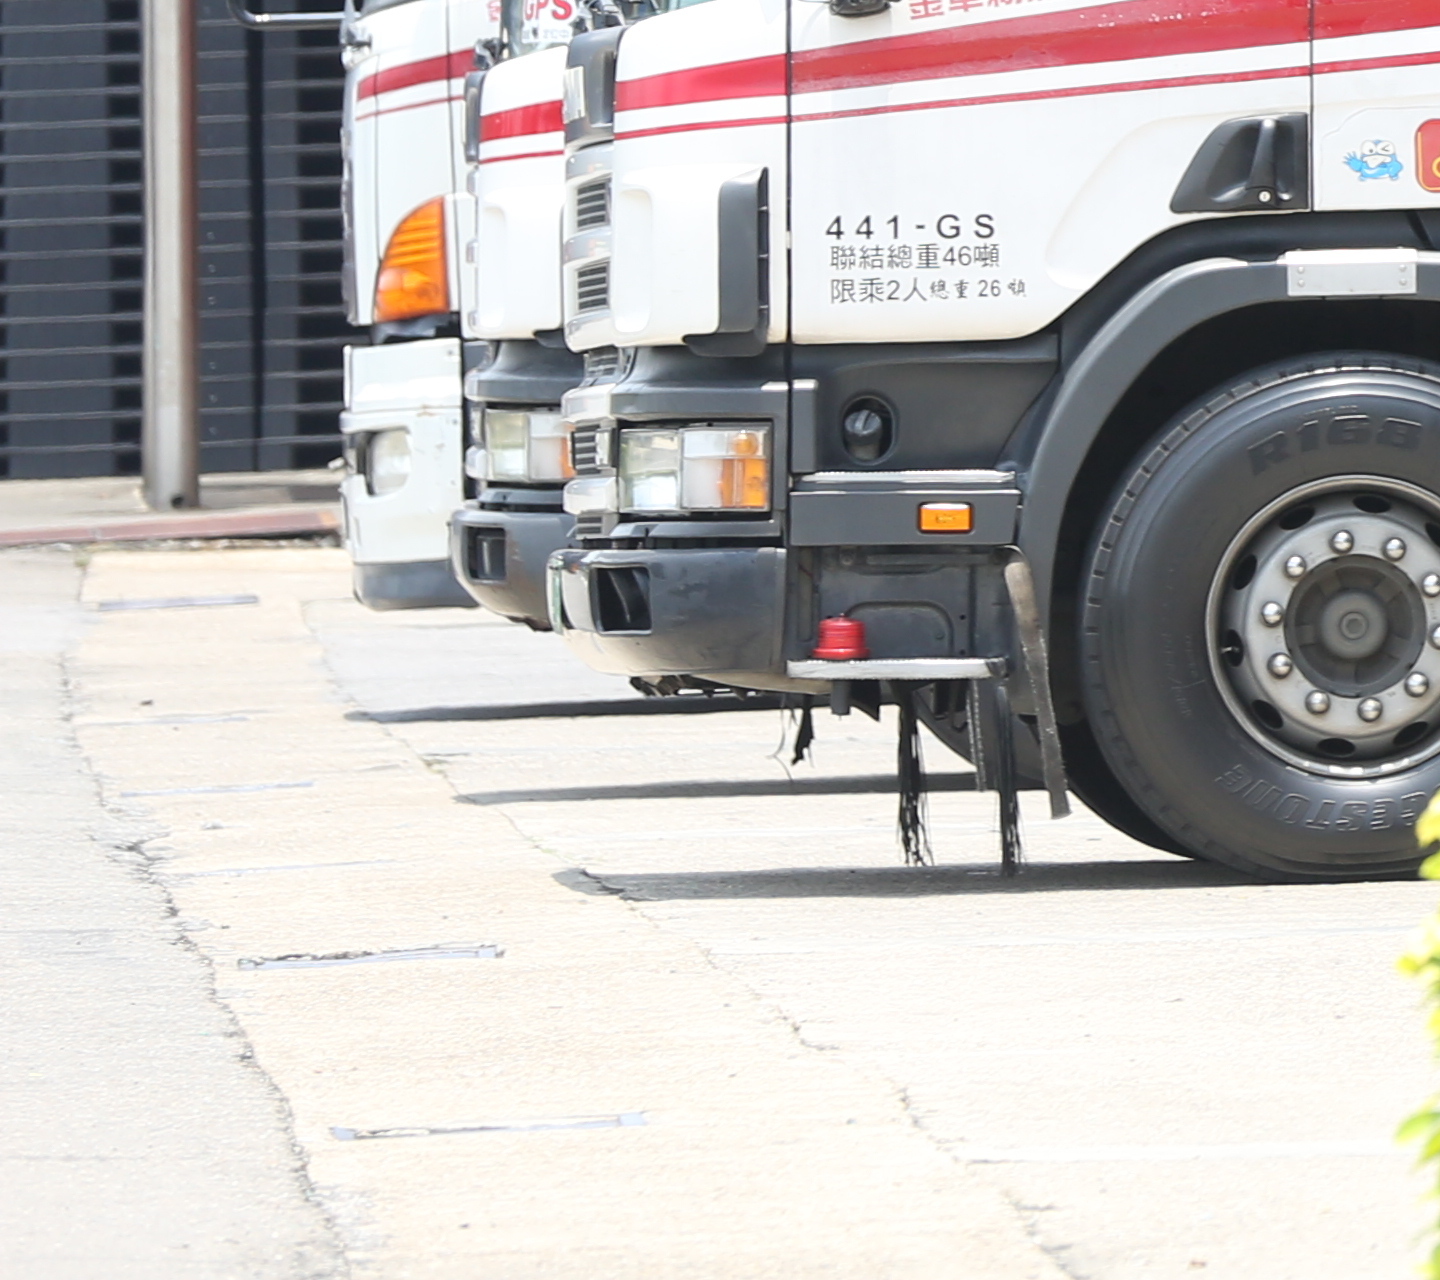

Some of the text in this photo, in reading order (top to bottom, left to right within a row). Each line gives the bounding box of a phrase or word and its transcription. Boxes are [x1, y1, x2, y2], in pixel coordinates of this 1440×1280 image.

[830, 243, 1000, 270] 聯結總重46噸
[1247, 414, 1424, 476] R168
